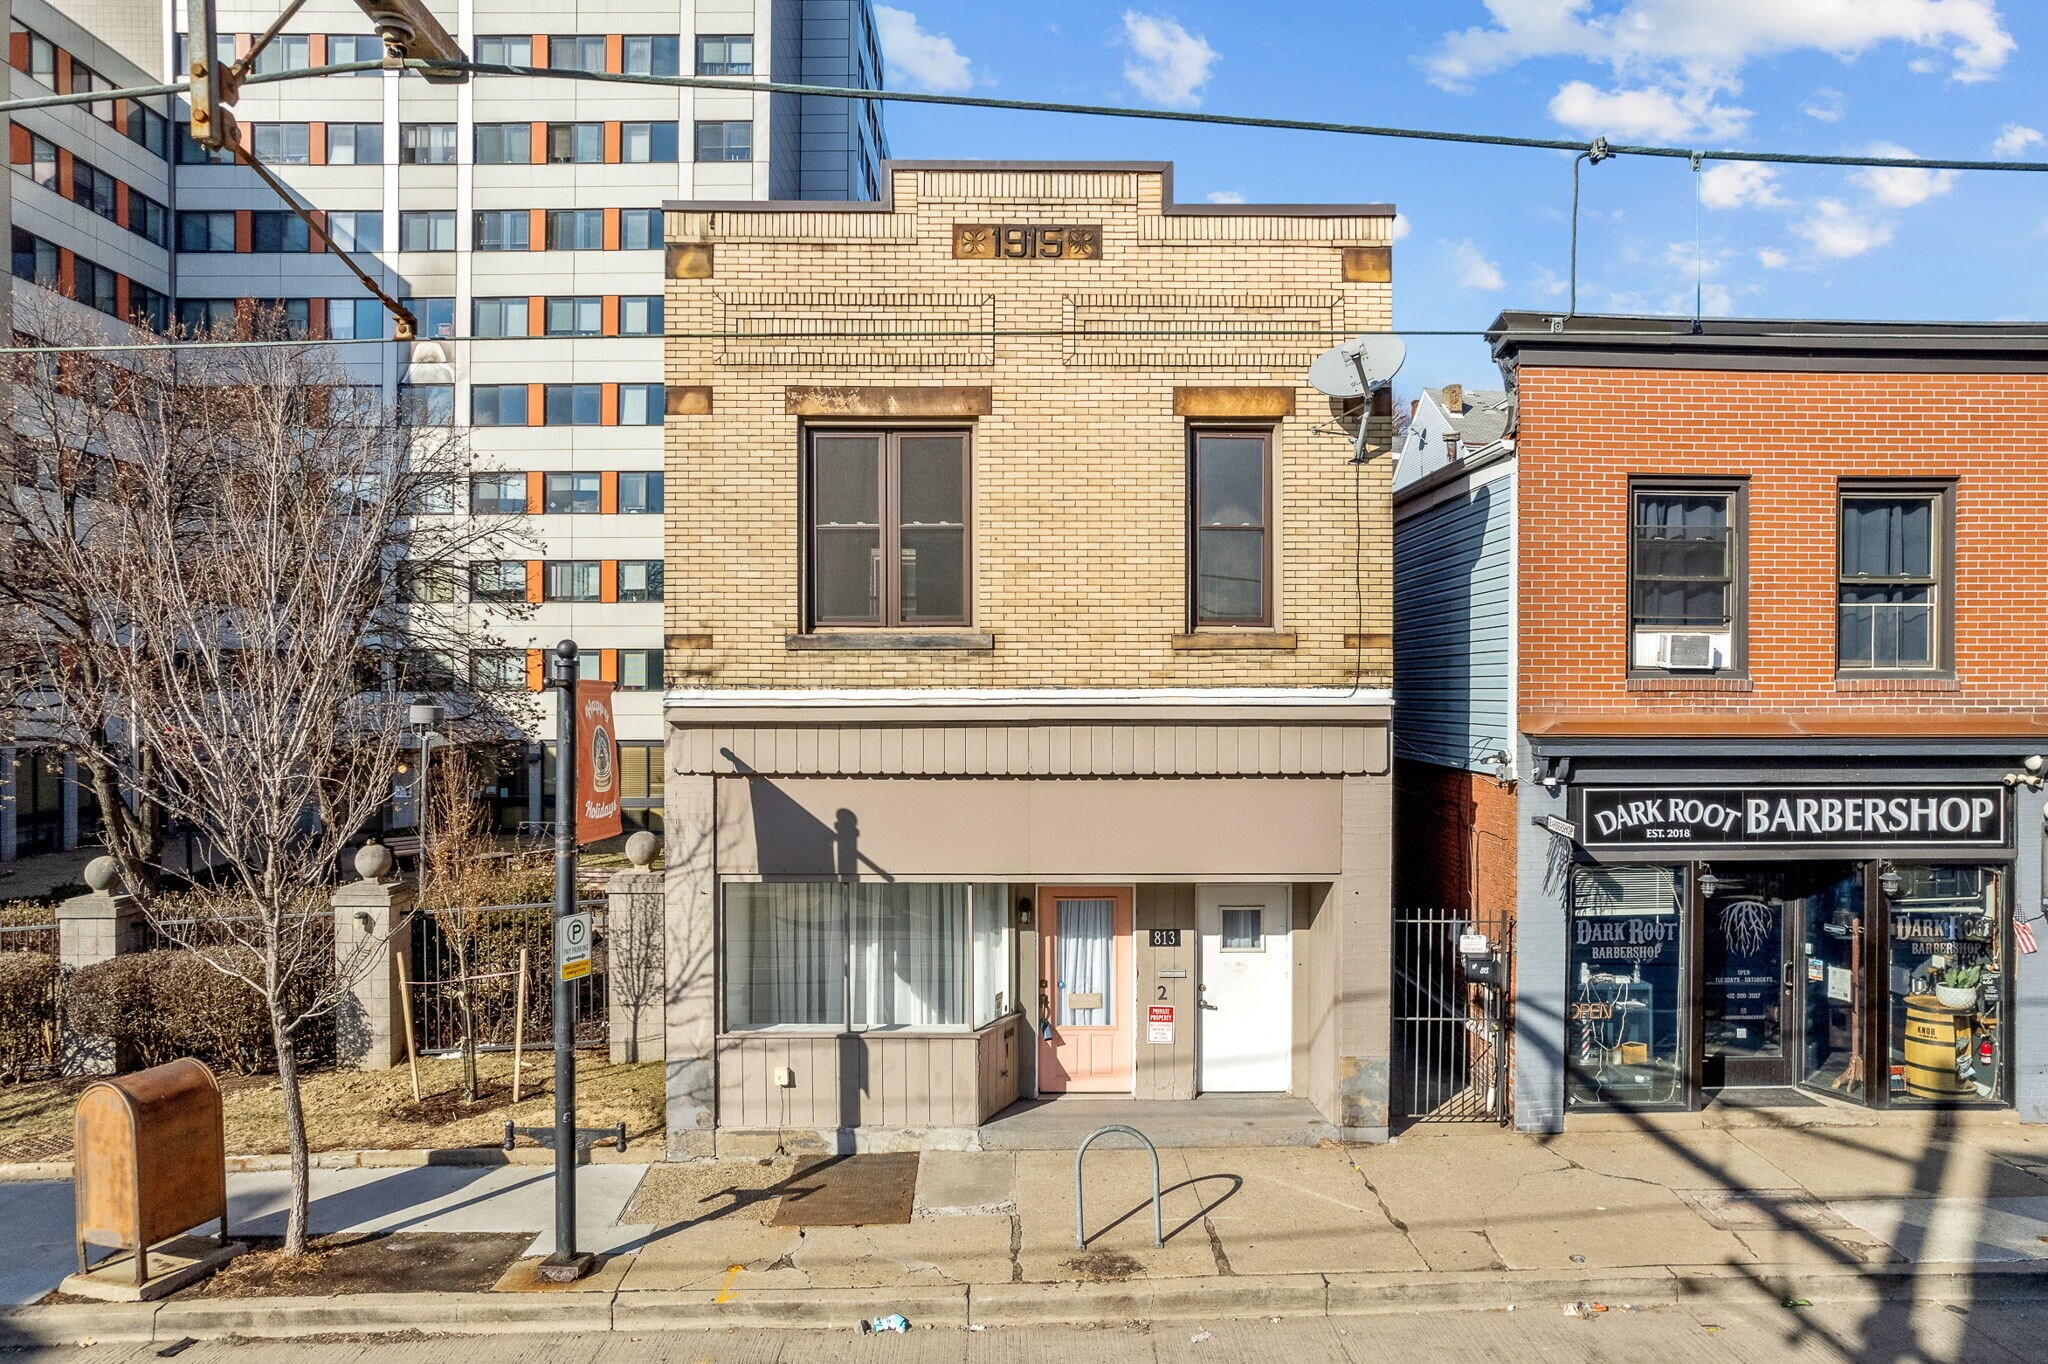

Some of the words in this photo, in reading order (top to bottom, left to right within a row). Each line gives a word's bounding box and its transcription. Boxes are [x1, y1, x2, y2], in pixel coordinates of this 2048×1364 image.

[992, 226, 1062, 258] 1915
[585, 699, 609, 723] Happy
[585, 800, 617, 819] Holidays
[1594, 799, 1665, 836] DARK
[1668, 798, 1742, 833] ROOT
[1747, 797, 1994, 833] BARBERSHOP
[1646, 829, 1665, 838] EST.
[1667, 829, 1691, 838] 2018
[572, 924, 581, 940] P
[1154, 930, 1175, 945] 813
[1591, 946, 1662, 959] BARBERSHOP
[1911, 942, 1982, 955] BARBERSHOP
[1157, 985, 1168, 1000] 2
[1571, 1003, 1613, 1019] OPEN
[1917, 1026, 1936, 1036] KNOB
